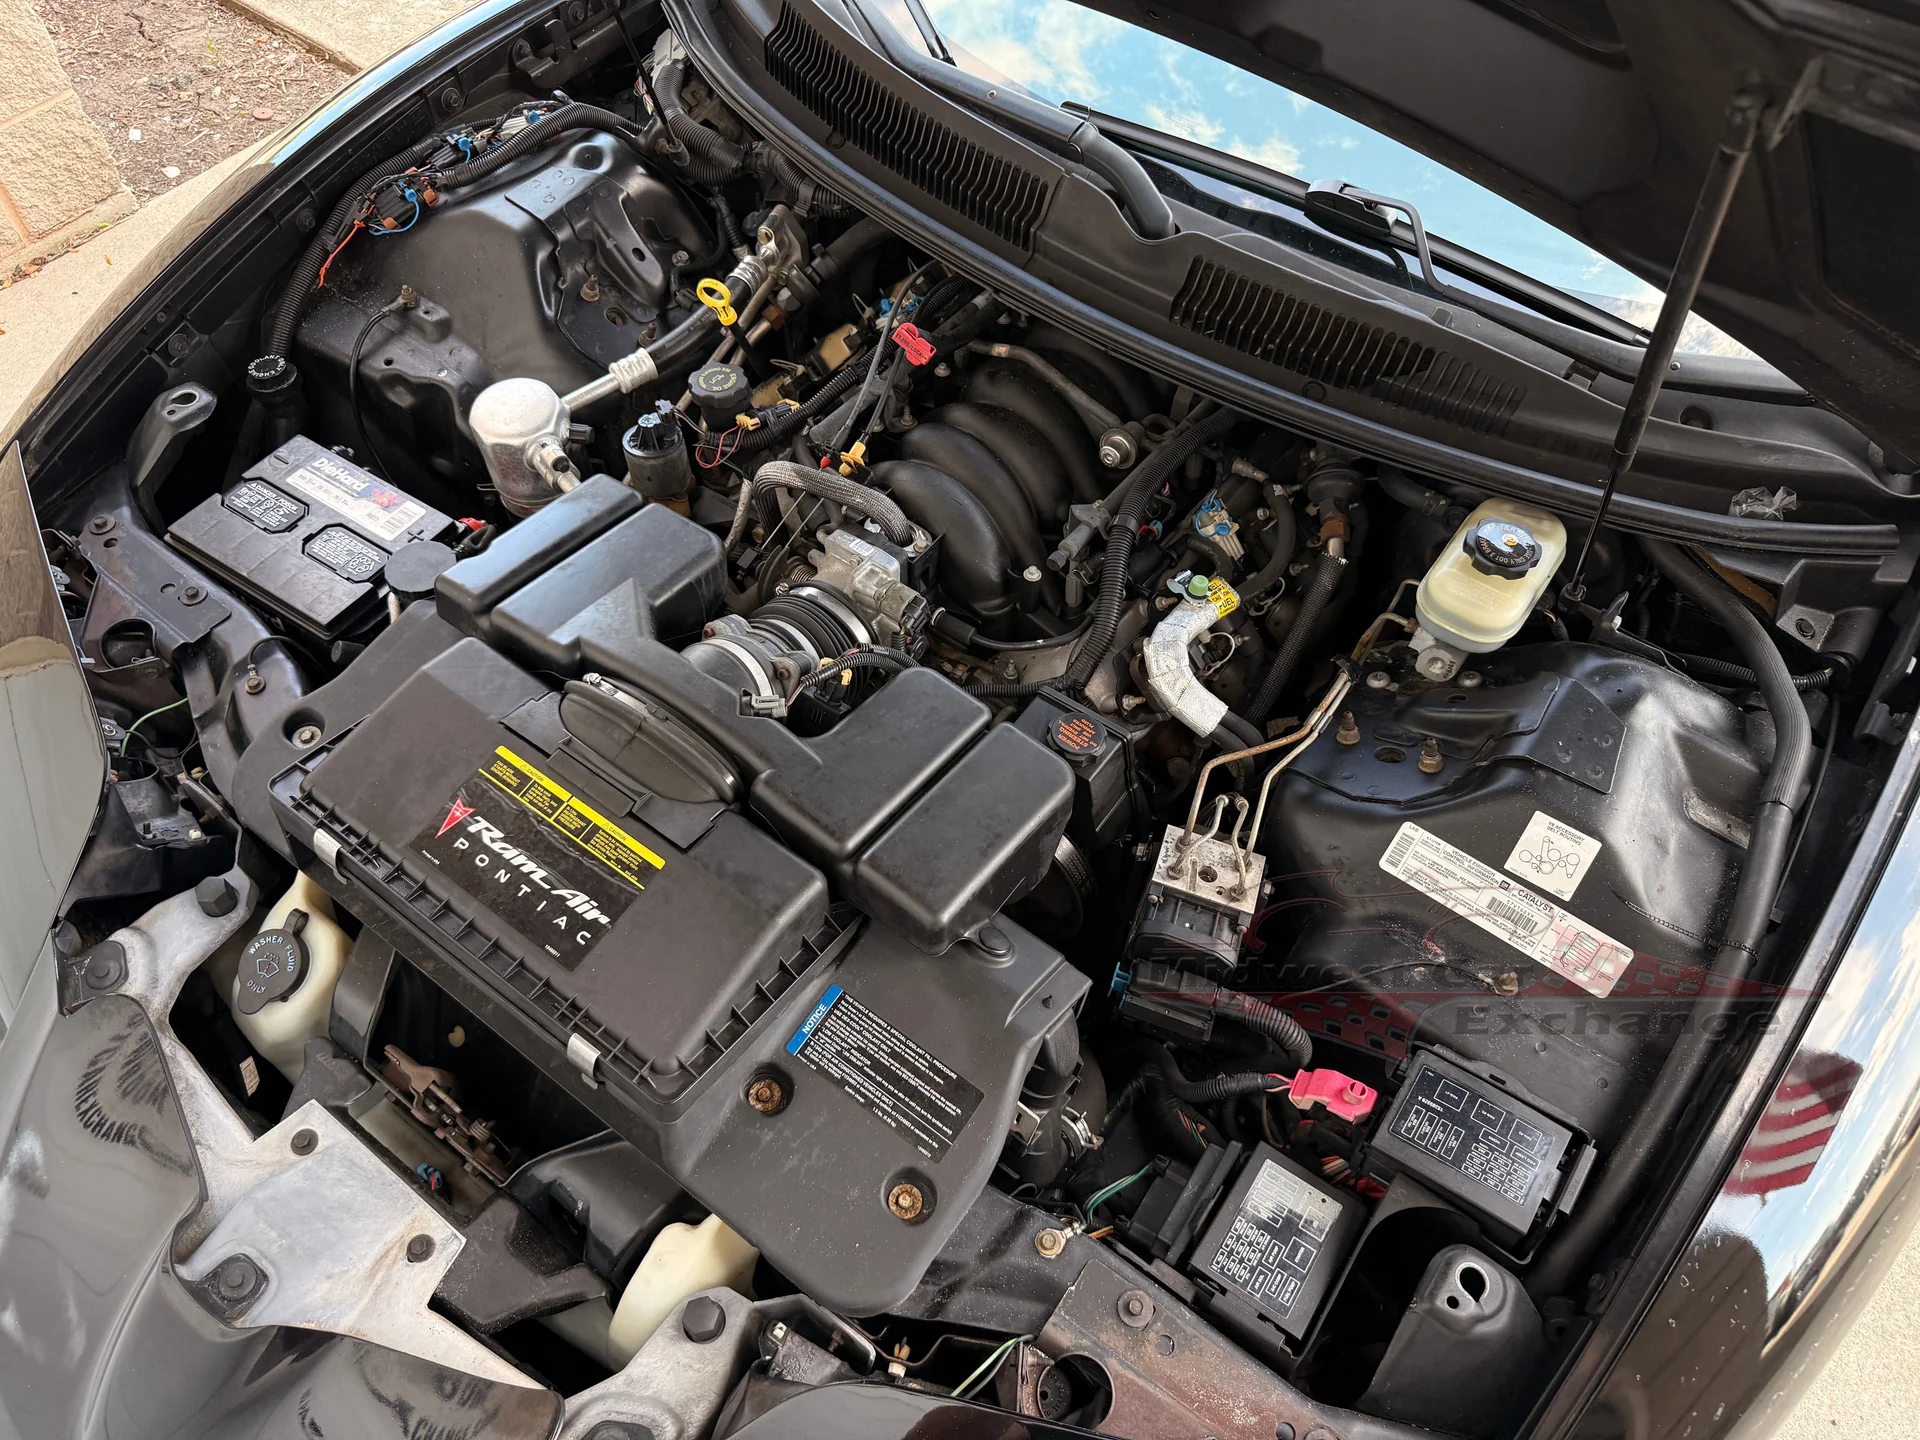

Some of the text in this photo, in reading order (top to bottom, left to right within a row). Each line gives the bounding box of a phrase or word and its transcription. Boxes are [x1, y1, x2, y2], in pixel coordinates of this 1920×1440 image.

[248, 354, 280, 369] COOLANT
[311, 456, 370, 491] DieHard
[255, 484, 277, 498] DANGER
[278, 498, 298, 511] POISON
[1495, 555, 1509, 563] DOT
[1510, 557, 1526, 565] ONLY
[1057, 733, 1080, 750] POWER
[526, 767, 544, 782] CAUTION
[608, 826, 627, 841] CAUTION
[1546, 825, 1581, 846] BELT ROUTING
[1554, 824, 1585, 842] ACCESSORY
[466, 815, 611, 924] Ram Air
[1442, 849, 1465, 865] CONTROL
[1466, 864, 1499, 884] INFORMATION
[1451, 849, 1472, 863] VEHICLE
[1472, 861, 1495, 877] EMISSION
[452, 837, 592, 946] PONTIAC
[1516, 888, 1554, 914] CATALYST
[248, 935, 296, 972] WASHER FLUID
[247, 980, 267, 994] ONLY
[802, 1004, 828, 1035] NOTICE
[832, 1008, 842, 1017] USE
[861, 1029, 881, 1045] COOLANT
[879, 1042, 891, 1053] ONLY
[852, 1000, 869, 1014] VEHICLE
[867, 1011, 887, 1028] REQUIRES
[889, 1028, 906, 1042] SPECIAL
[905, 1039, 925, 1055] COOLANT
[923, 1053, 933, 1062] FILL
[932, 1059, 957, 1079] PROCEDURE
[849, 1048, 871, 1065] INDICATOR
[830, 1057, 839, 1065] AIR
[837, 1062, 864, 1083] CONDITIONED
[861, 1080, 882, 1097] VEHICLES
[1271, 1245, 1279, 1256] PUMP
[1273, 1273, 1282, 1284] COMP
[1282, 1281, 1296, 1301] FUEL PUMP
